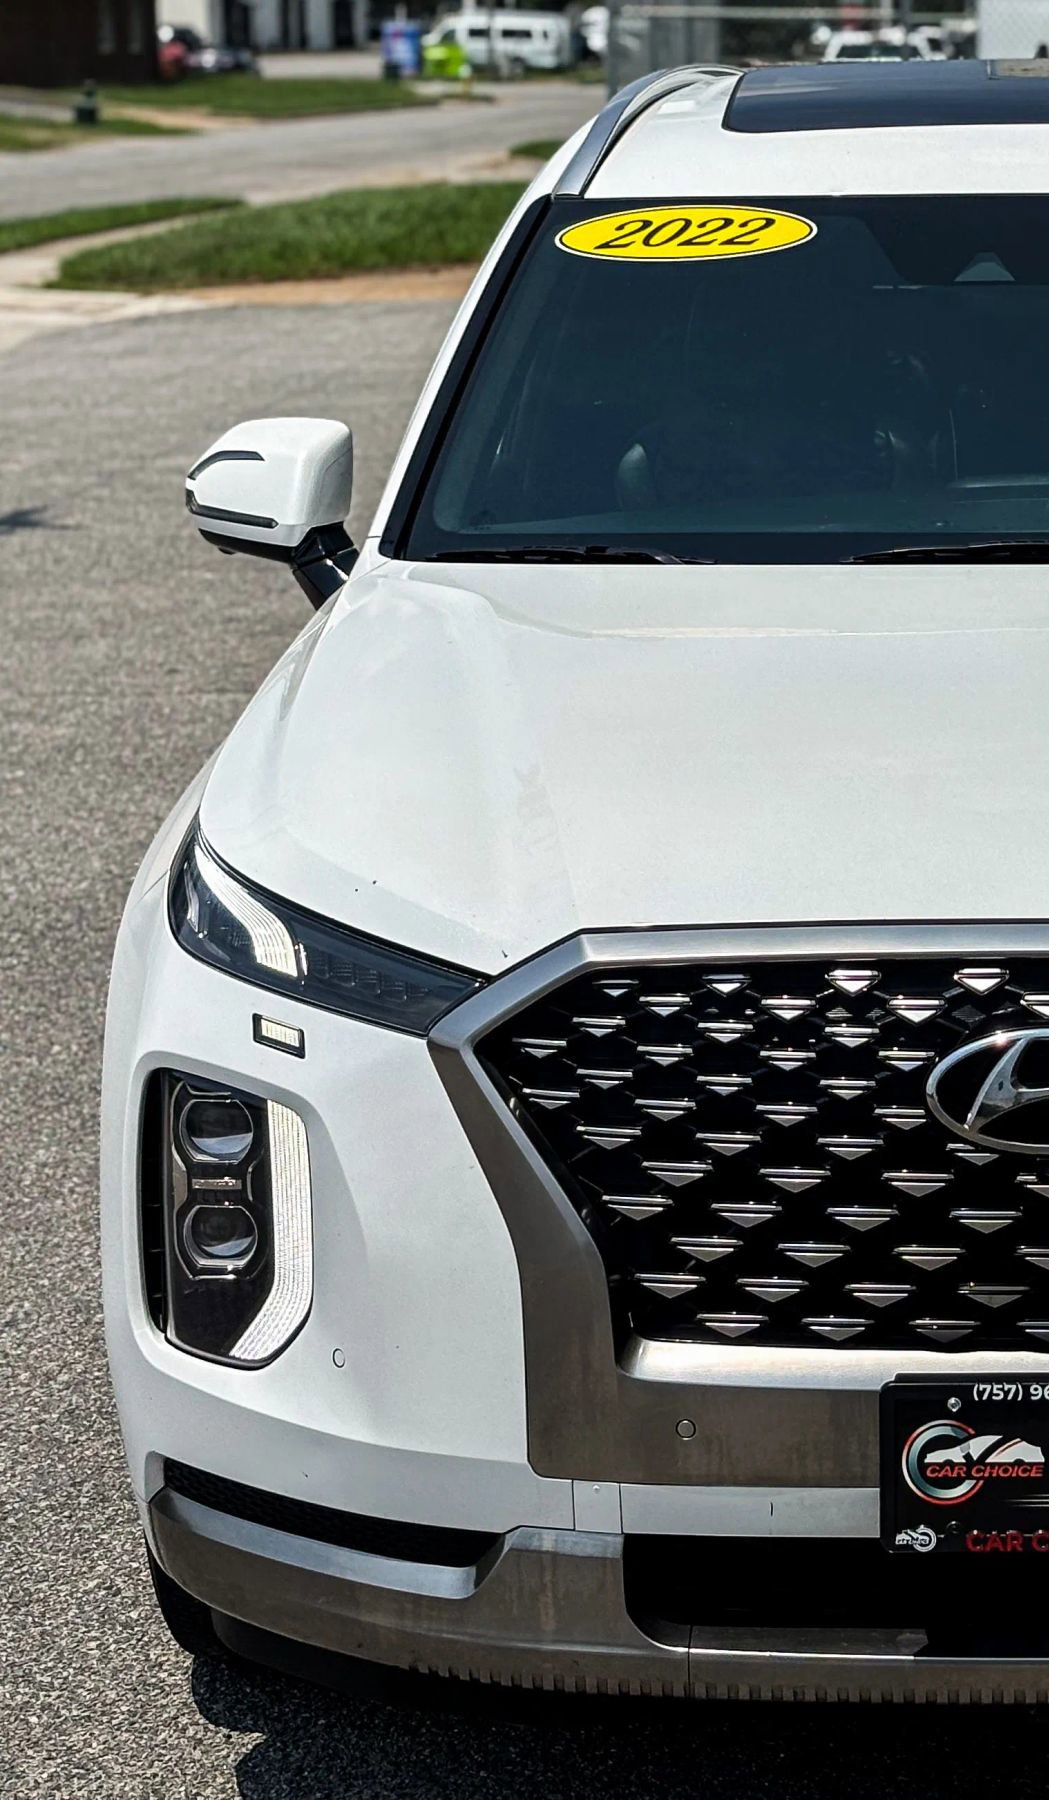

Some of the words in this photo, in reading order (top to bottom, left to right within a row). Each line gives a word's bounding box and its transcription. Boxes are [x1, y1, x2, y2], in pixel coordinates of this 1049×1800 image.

[594, 217, 776, 250] 2022
[972, 1384, 1023, 1401] (757)
[926, 1465, 967, 1478] CAR
[971, 1465, 1044, 1478] CHOICE
[965, 1531, 1023, 1552] CAR
